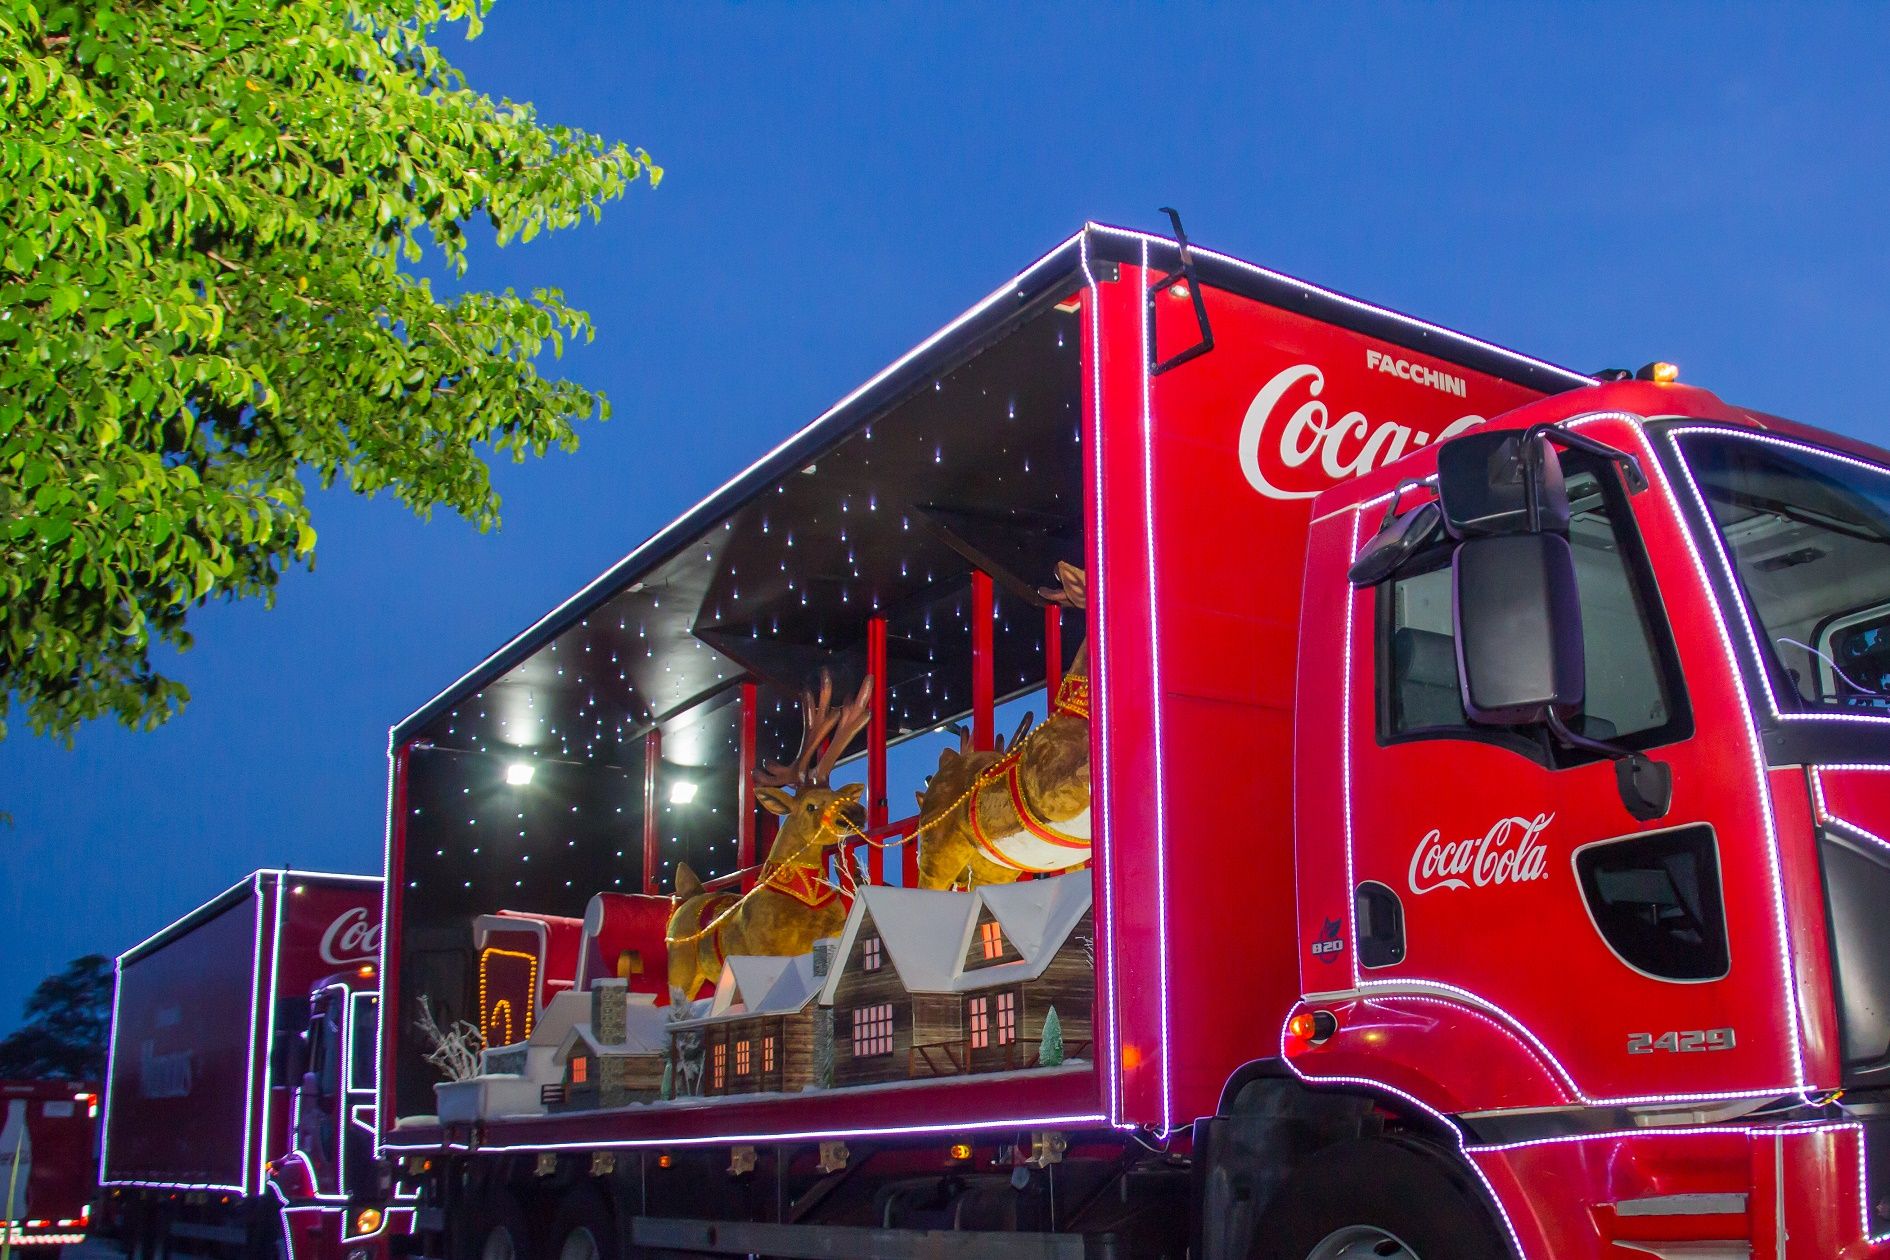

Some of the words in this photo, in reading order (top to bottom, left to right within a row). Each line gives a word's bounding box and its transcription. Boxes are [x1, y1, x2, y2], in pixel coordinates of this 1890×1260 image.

[1366, 349, 1467, 398] FACCHINI
[1408, 811, 1555, 895] Coca-Cola
[1627, 1027, 1736, 1054] 2429
